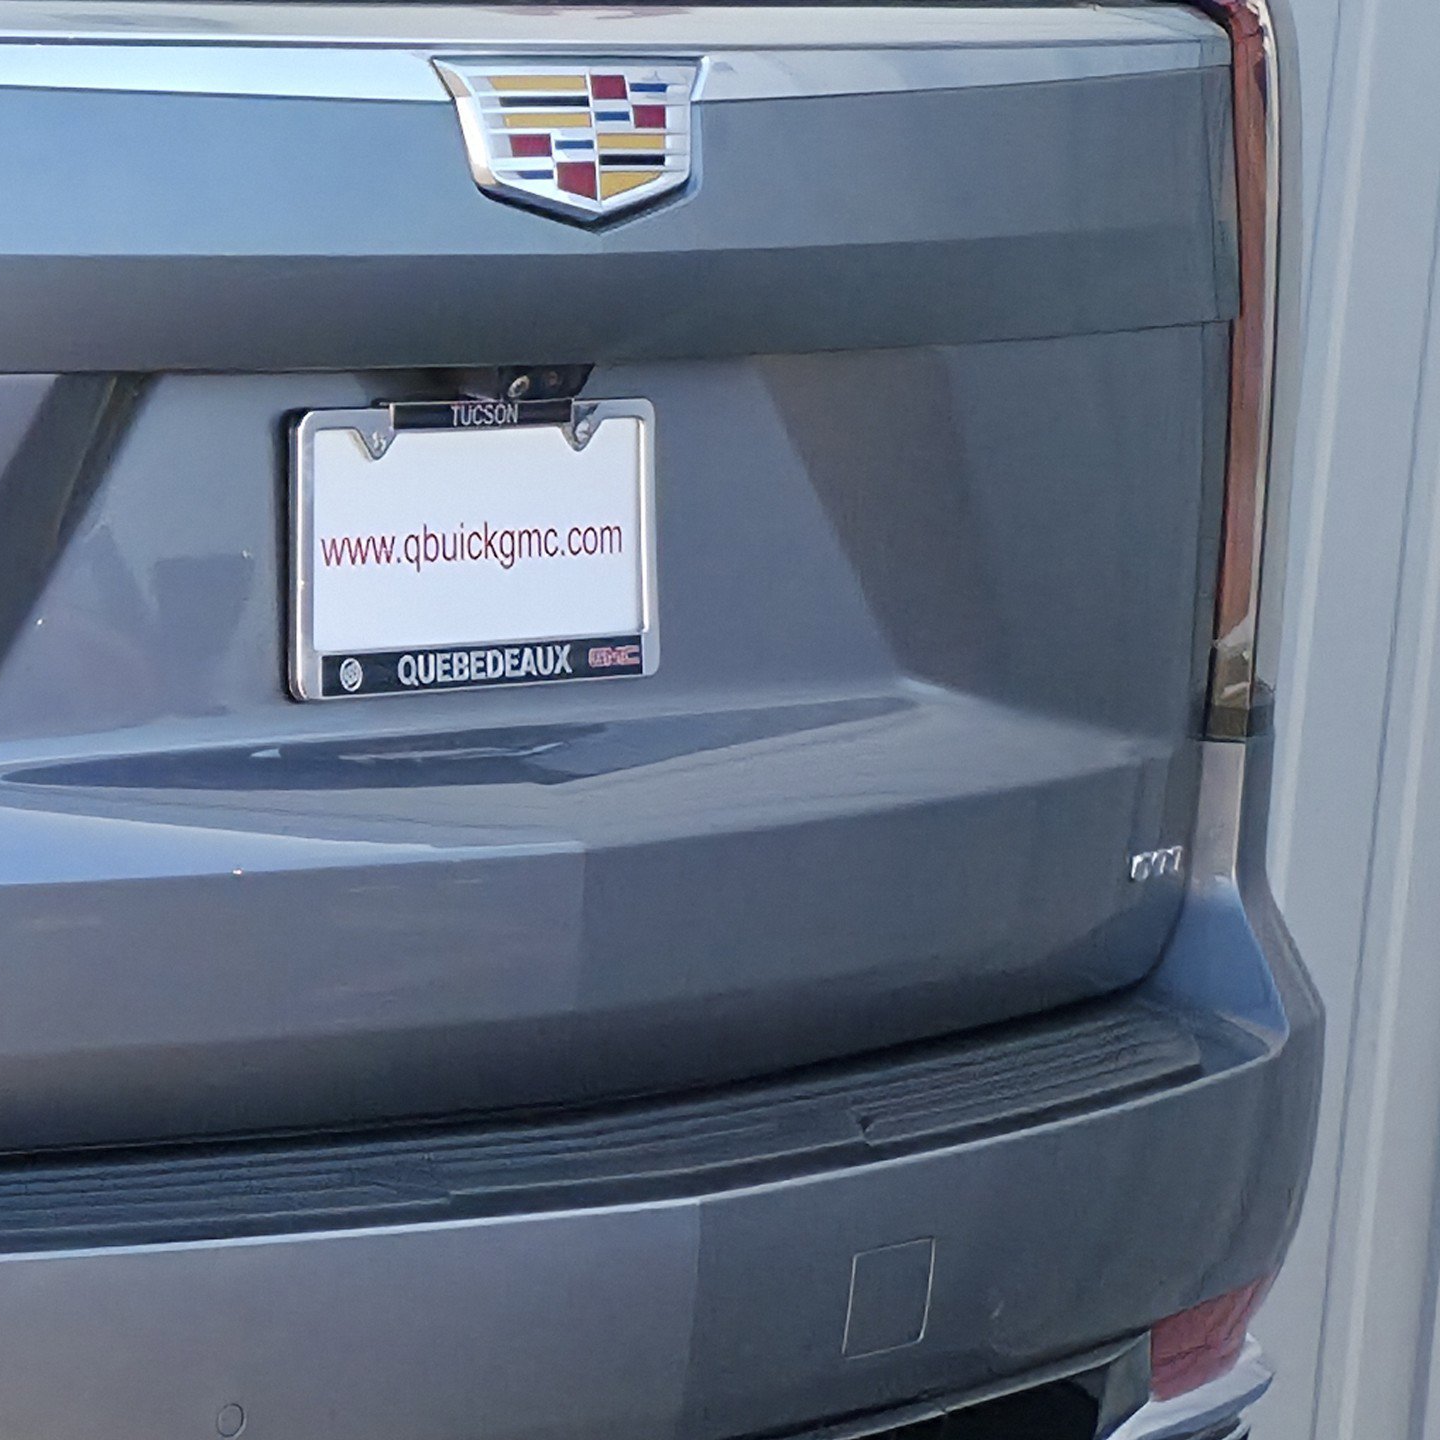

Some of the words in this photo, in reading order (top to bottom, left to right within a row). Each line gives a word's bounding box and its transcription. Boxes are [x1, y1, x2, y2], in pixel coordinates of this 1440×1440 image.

[450, 402, 519, 428] TUCSON
[321, 521, 623, 572] www.qbuickgmc.com
[397, 644, 573, 687] QUEBEDEAUX
